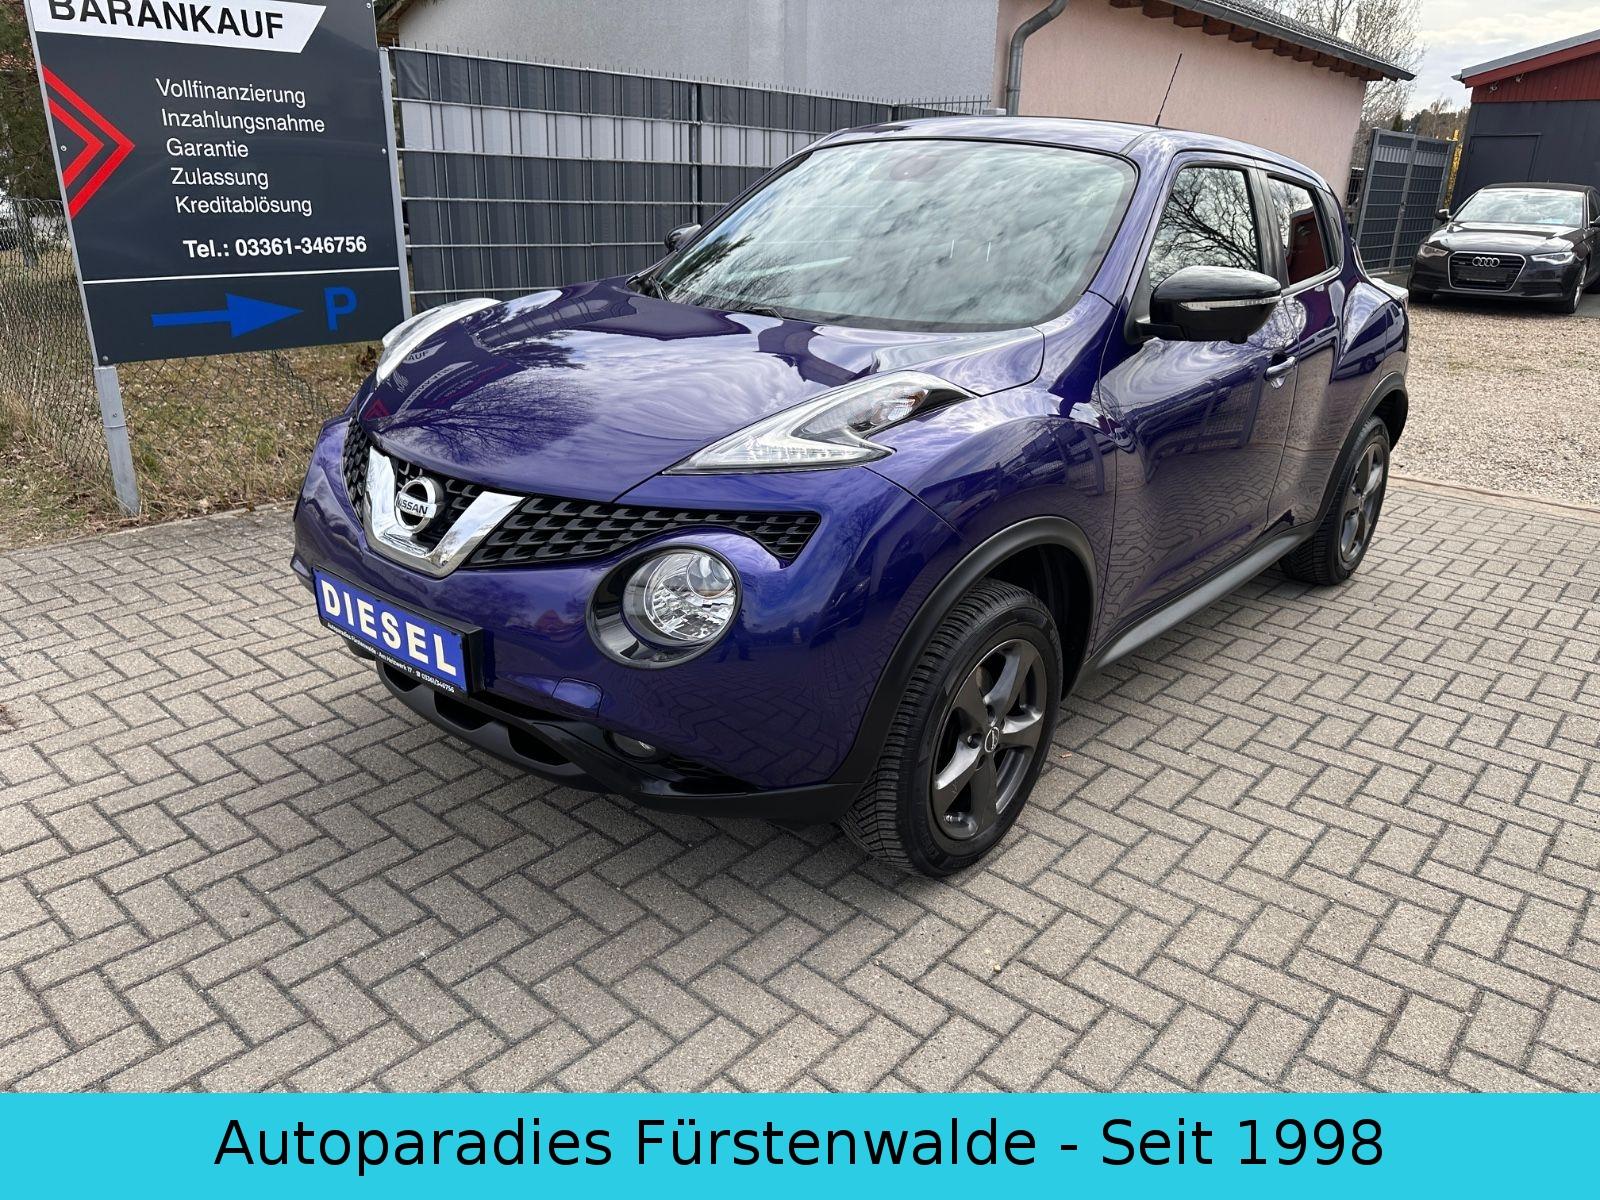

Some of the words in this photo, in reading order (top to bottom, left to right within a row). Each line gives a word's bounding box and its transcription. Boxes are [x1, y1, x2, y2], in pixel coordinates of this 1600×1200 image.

[49, 0, 283, 39] BARANKAUF
[155, 78, 306, 108] Vollfinanzierung
[161, 109, 325, 134] Inzahlungsnahme
[166, 138, 249, 158] Garantie
[170, 167, 269, 190] Zulassung
[175, 195, 312, 217] Kreditablösung
[182, 239, 230, 259] Tel.:
[235, 235, 367, 257] 03361-346756
[324, 287, 357, 331] P
[321, 580, 457, 677] DIESEL
